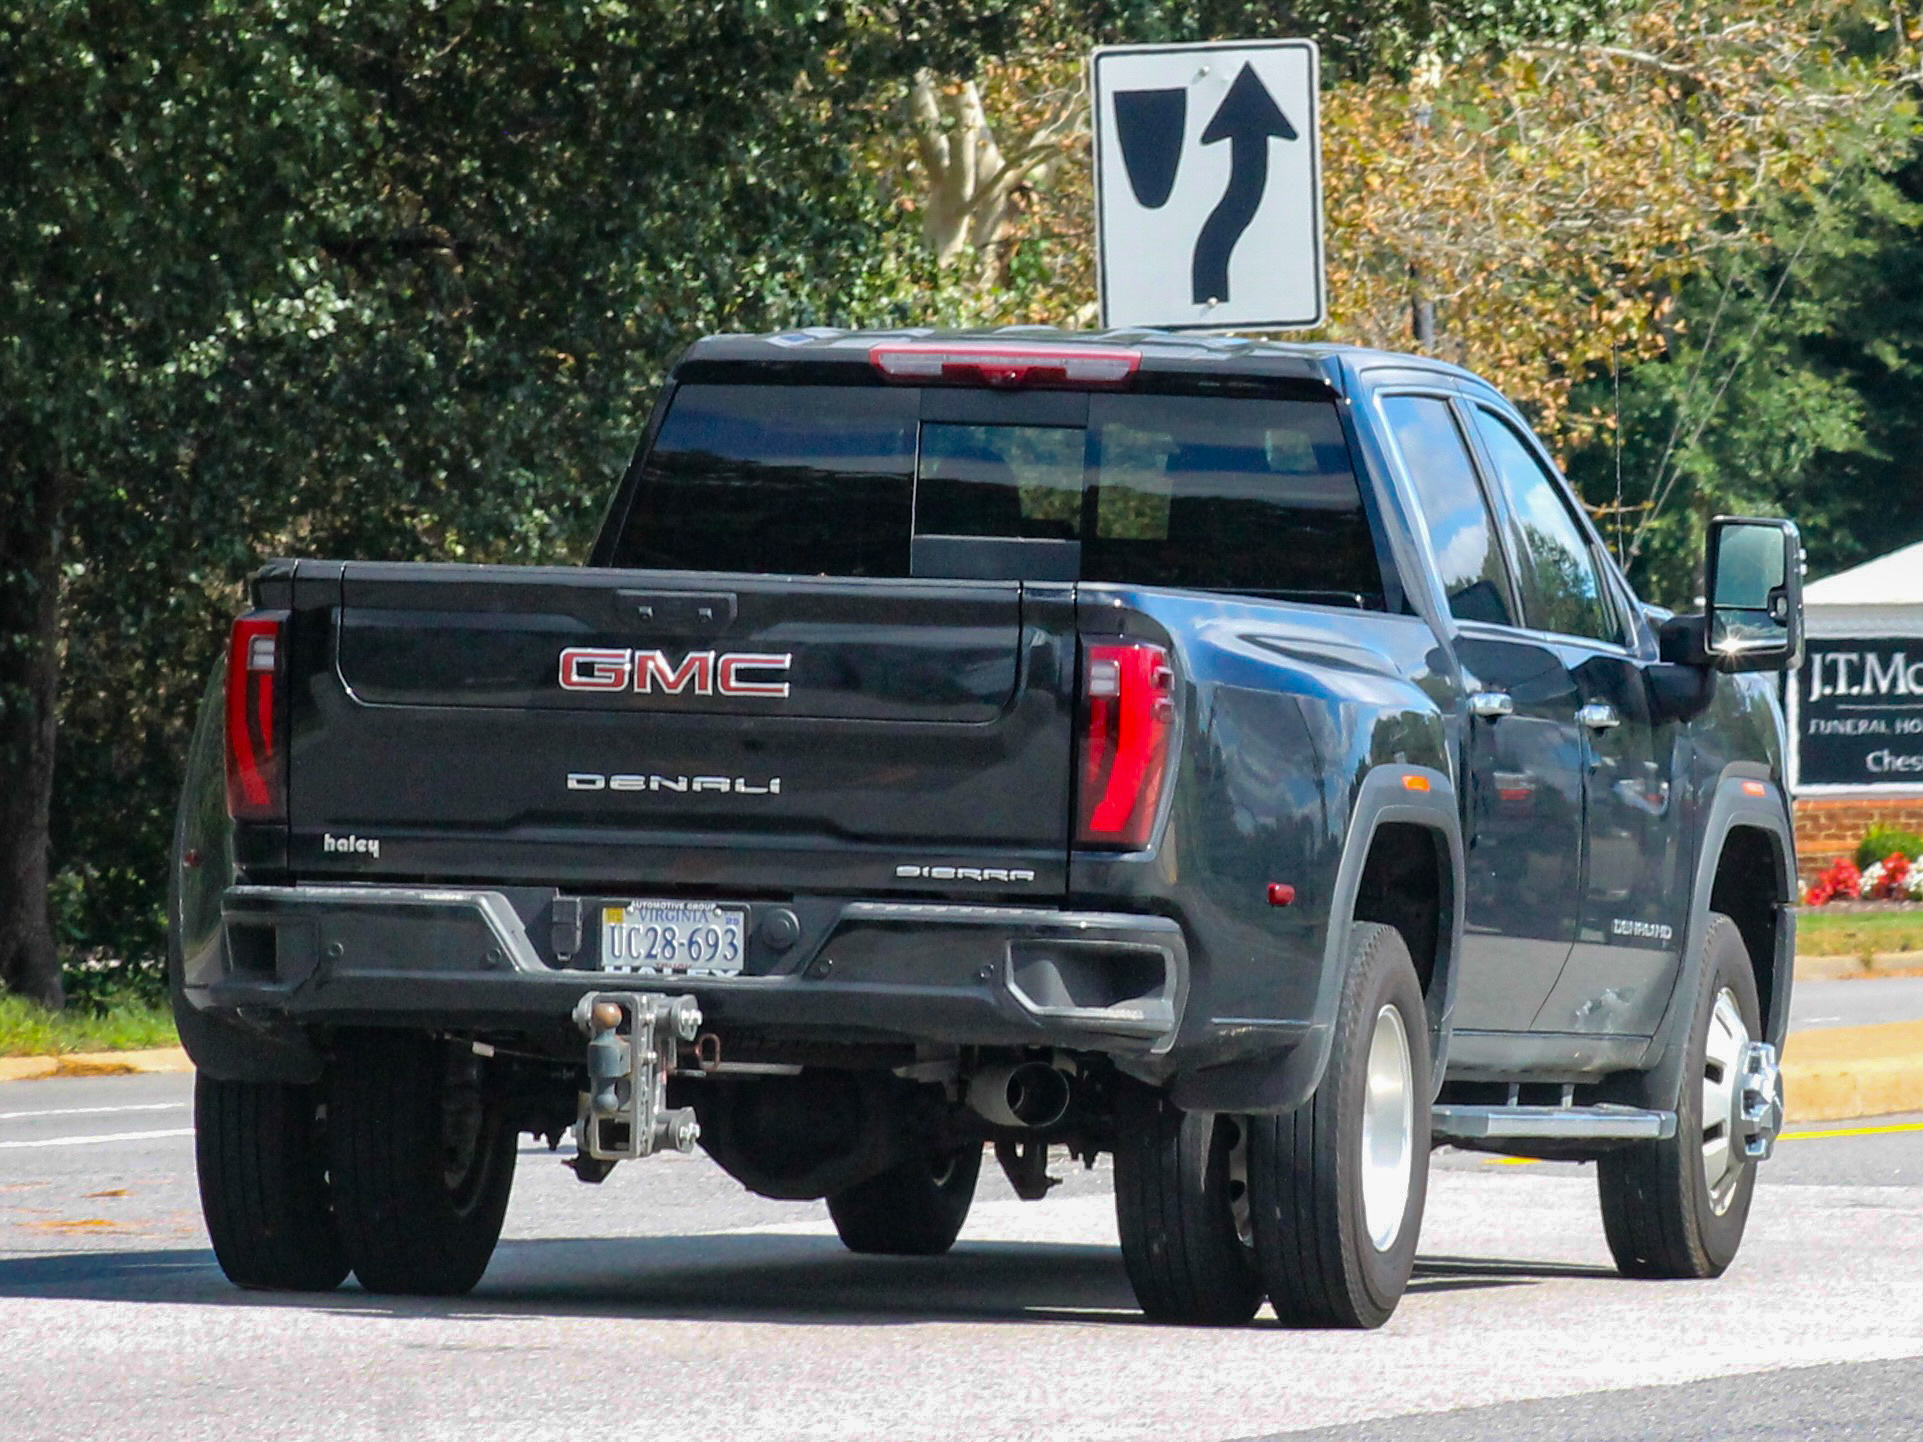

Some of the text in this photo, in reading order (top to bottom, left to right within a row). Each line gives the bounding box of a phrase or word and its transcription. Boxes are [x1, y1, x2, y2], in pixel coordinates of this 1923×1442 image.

[559, 648, 793, 698] GMC
[1808, 718, 1889, 735] FUNERAL
[567, 773, 782, 794] DENALI
[323, 833, 380, 858] haley
[896, 865, 1036, 881] SIERRA
[631, 900, 717, 911] AUTOMOTIVE GROUP
[639, 909, 710, 923] VIRGINIA
[609, 924, 739, 962] UC28-693
